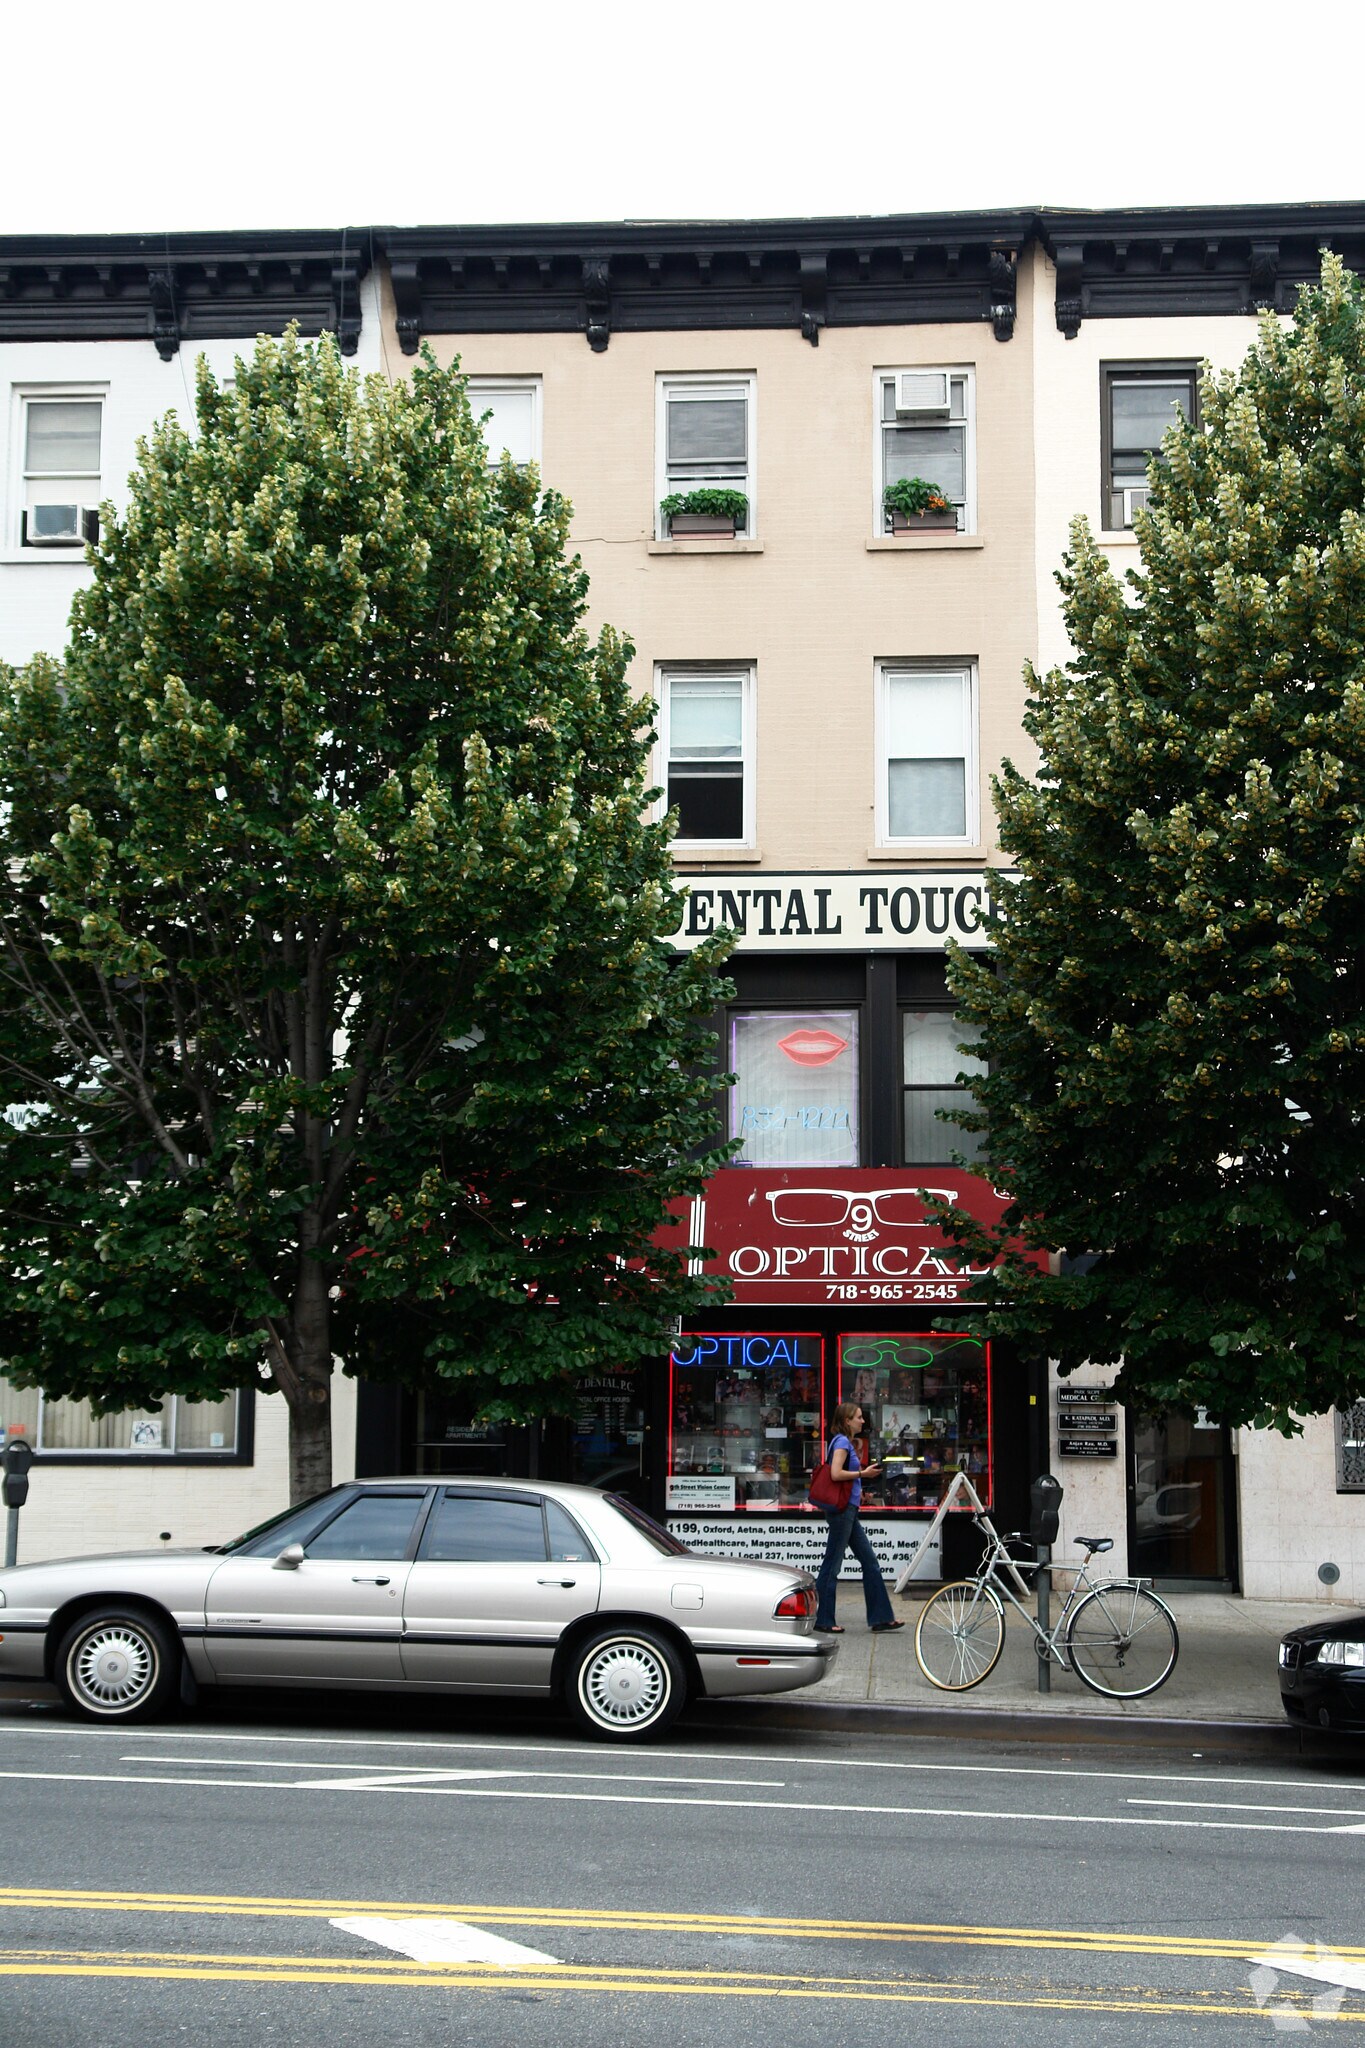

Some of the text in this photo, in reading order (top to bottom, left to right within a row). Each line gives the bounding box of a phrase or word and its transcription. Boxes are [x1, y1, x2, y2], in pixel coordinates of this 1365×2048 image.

[663, 889, 842, 936] ENTAL
[8, 1111, 26, 1124] AW
[743, 1105, 849, 1129] 832-1222
[851, 1204, 873, 1232] 9
[842, 1229, 880, 1243] STREET
[668, 1523, 701, 1535] 1199,
[703, 1525, 735, 1535] Oxford,
[737, 1526, 766, 1535] Aetna,
[768, 1526, 815, 1536] GHI-BCBS,
[751, 1539, 804, 1549] Magnacare,
[897, 1541, 940, 1550] Medire
[765, 1552, 784, 1561] 237,
[786, 1552, 826, 1561] Ironwork
